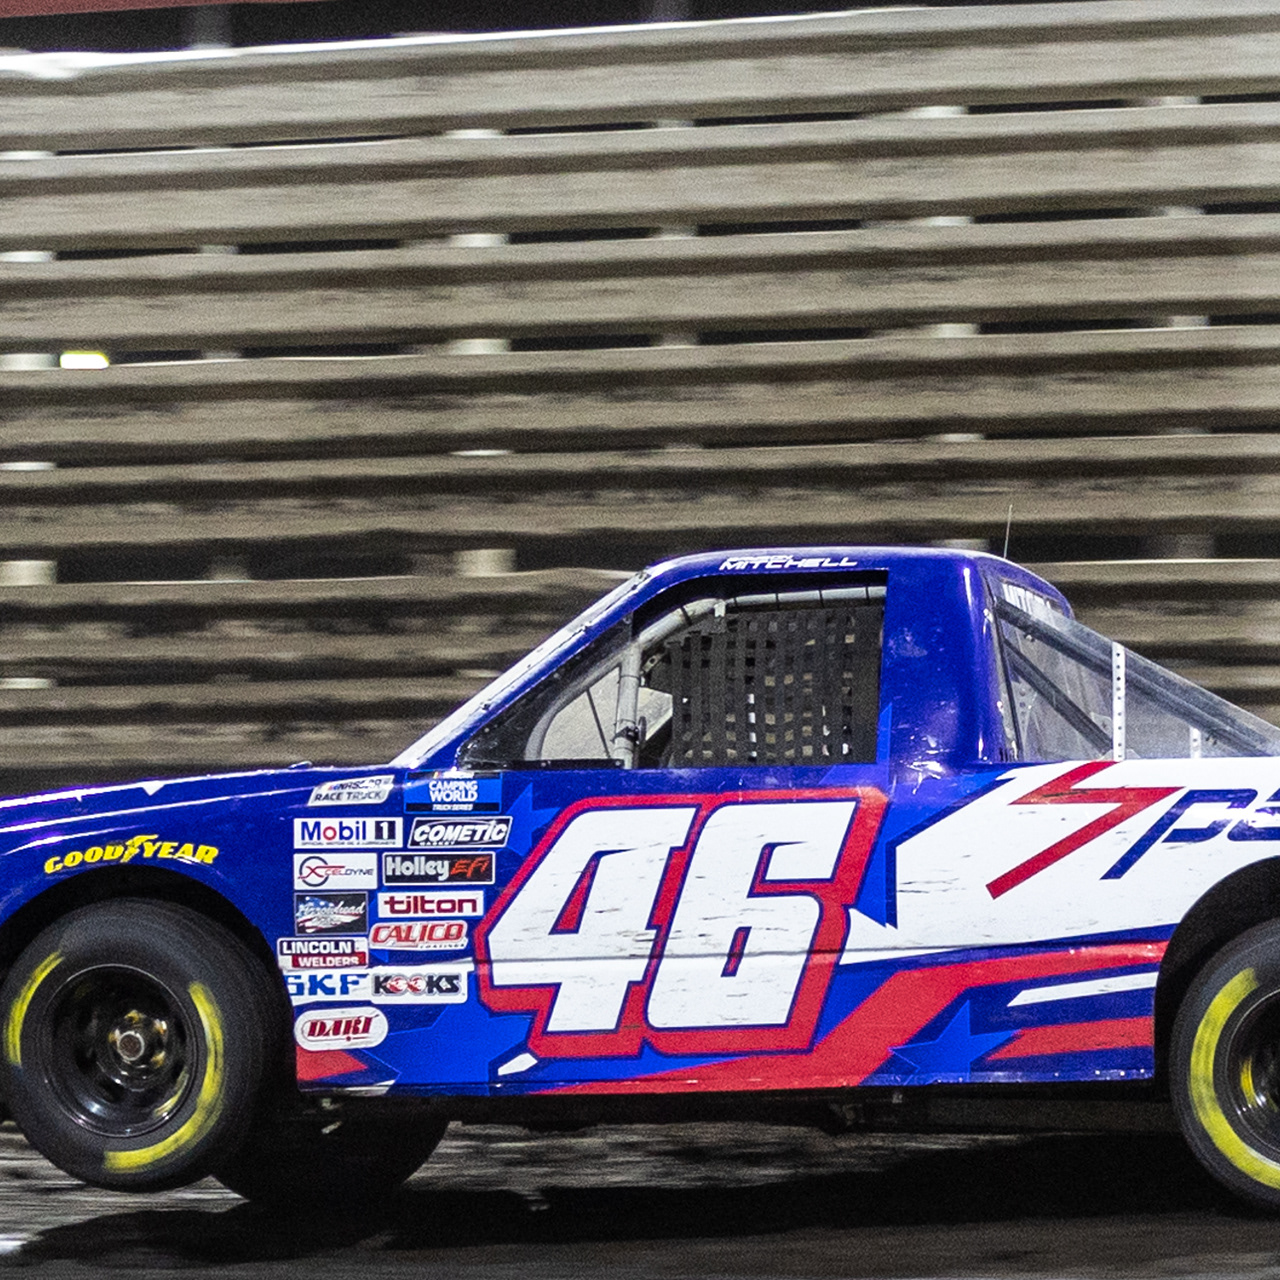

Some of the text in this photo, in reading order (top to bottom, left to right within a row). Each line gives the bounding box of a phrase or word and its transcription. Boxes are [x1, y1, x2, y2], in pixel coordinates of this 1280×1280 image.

[719, 557, 858, 571] MITCHELL
[428, 780, 479, 791] CAMPING
[315, 791, 382, 801] RACE TRUCK
[429, 790, 479, 802] WORLD
[301, 820, 367, 841] Mobil
[414, 820, 508, 842] COMETIC
[44, 834, 219, 874] GOODYEAR
[386, 856, 450, 881] Holley
[383, 895, 478, 914] tilton
[484, 797, 862, 1036] 46
[371, 923, 465, 943] CALICO
[282, 941, 352, 954] LINCOLN
[298, 956, 360, 967] WELDERS
[284, 974, 368, 996] SKF
[373, 974, 460, 995] KOOKS
